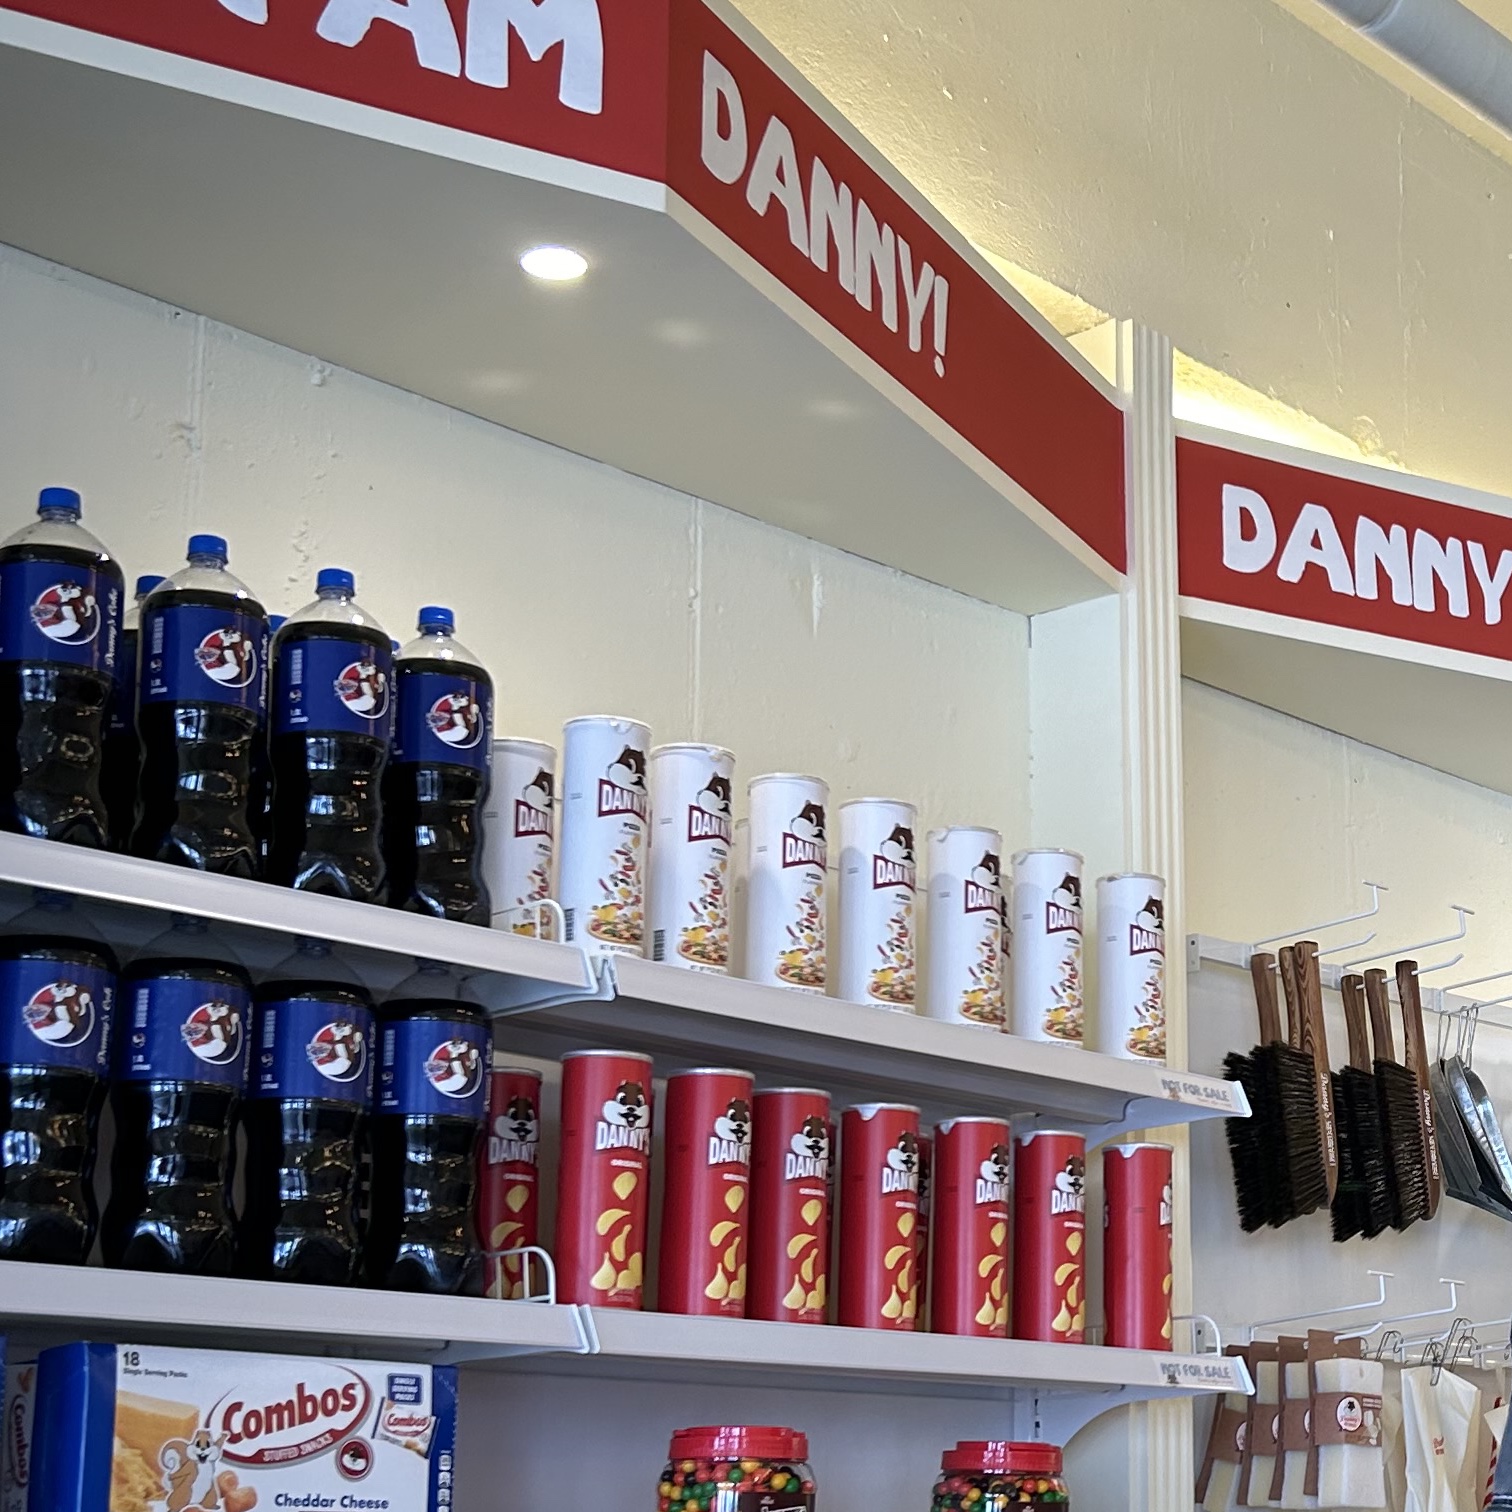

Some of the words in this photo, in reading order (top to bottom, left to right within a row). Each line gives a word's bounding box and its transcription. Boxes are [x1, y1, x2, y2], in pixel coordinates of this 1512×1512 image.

[701, 50, 951, 378] DANNY!
[1183, 1082, 1203, 1096] FOR
[1205, 1086, 1230, 1101] SALE
[123, 1351, 140, 1366] 18
[1183, 1364, 1202, 1377] FOR
[1204, 1365, 1232, 1379] SALE
[222, 1381, 357, 1445] Combos
[274, 1494, 337, 1508] Cheddar
[340, 1494, 389, 1509] Cheese
